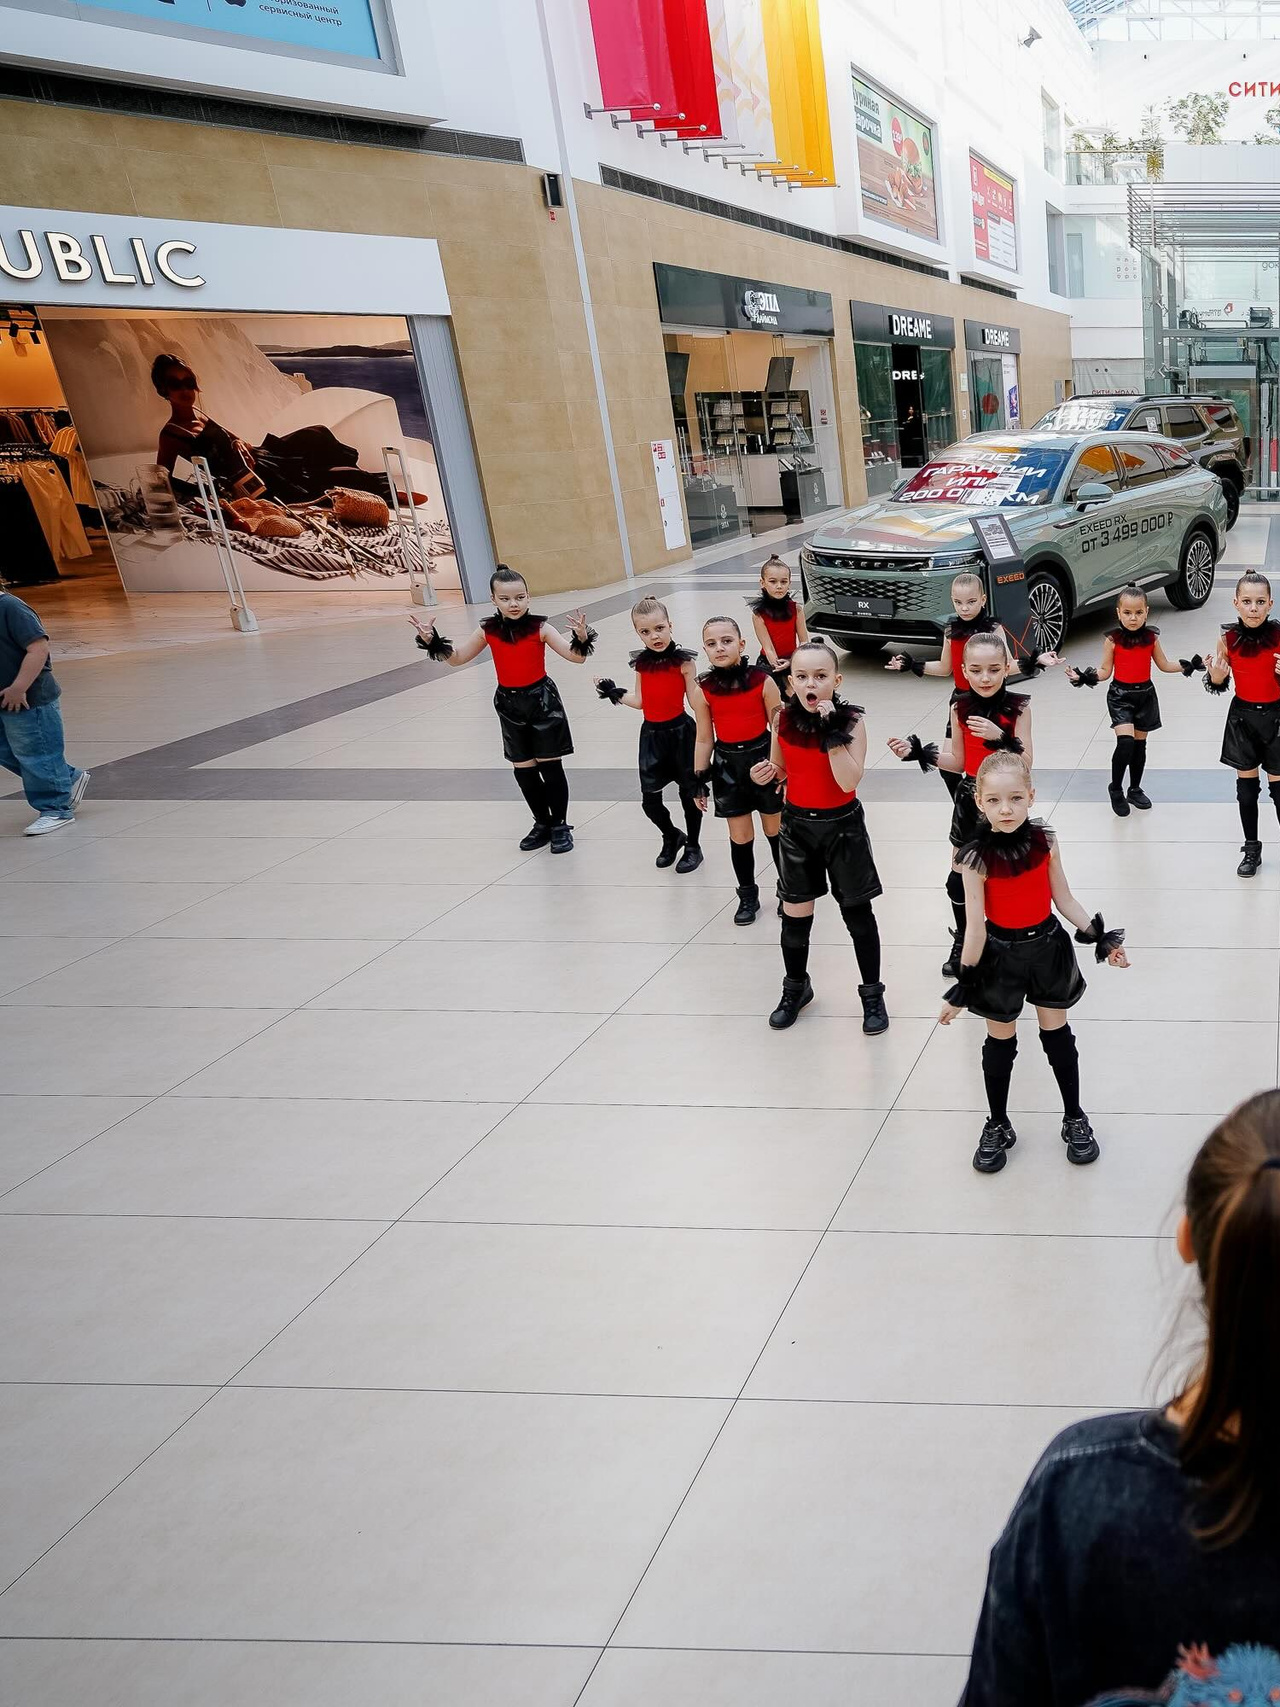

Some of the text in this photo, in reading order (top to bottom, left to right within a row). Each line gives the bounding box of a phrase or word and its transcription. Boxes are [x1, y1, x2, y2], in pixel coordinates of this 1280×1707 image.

[272, 0, 339, 14] оризованный
[259, 4, 342, 27] сервисный центр
[856, 111, 881, 138] арочка
[892, 314, 933, 339] DREAME
[984, 328, 1010, 347] DREAME
[892, 370, 925, 380] DRE
[922, 464, 1048, 478] ГАРАНТИИ
[899, 489, 944, 501] 200
[1080, 513, 1128, 536] EXEED RX
[1100, 530, 1110, 548] 3
[1113, 521, 1138, 542] 499
[1141, 514, 1165, 535] 000
[996, 572, 1025, 584] EXEED
[857, 601, 870, 609] RX
